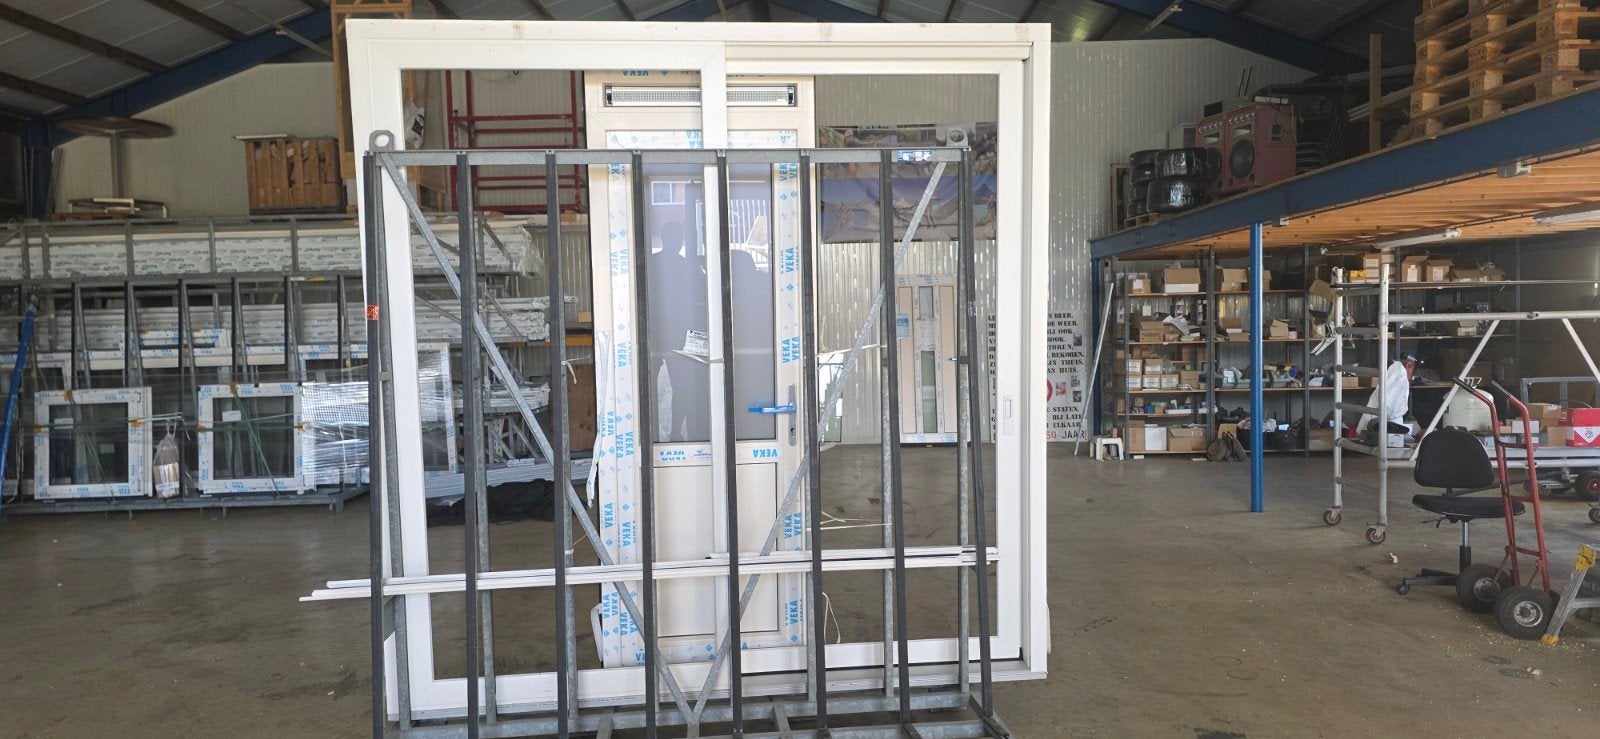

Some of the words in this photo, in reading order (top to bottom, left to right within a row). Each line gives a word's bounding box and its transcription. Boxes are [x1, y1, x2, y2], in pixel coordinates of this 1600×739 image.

[786, 247, 794, 272] VEKA
[617, 342, 626, 368] VEKA
[782, 338, 790, 363] VEKA
[792, 336, 800, 361] VEKA
[616, 434, 624, 458] VEKA
[626, 431, 634, 456] VEKA
[753, 448, 778, 457] VEKA
[604, 502, 613, 528] VEKA
[784, 515, 792, 539] VEKA
[794, 512, 802, 536] VEKA
[622, 521, 631, 547] VEKA
[620, 611, 628, 636] VEKA
[790, 600, 798, 625] VEKA
